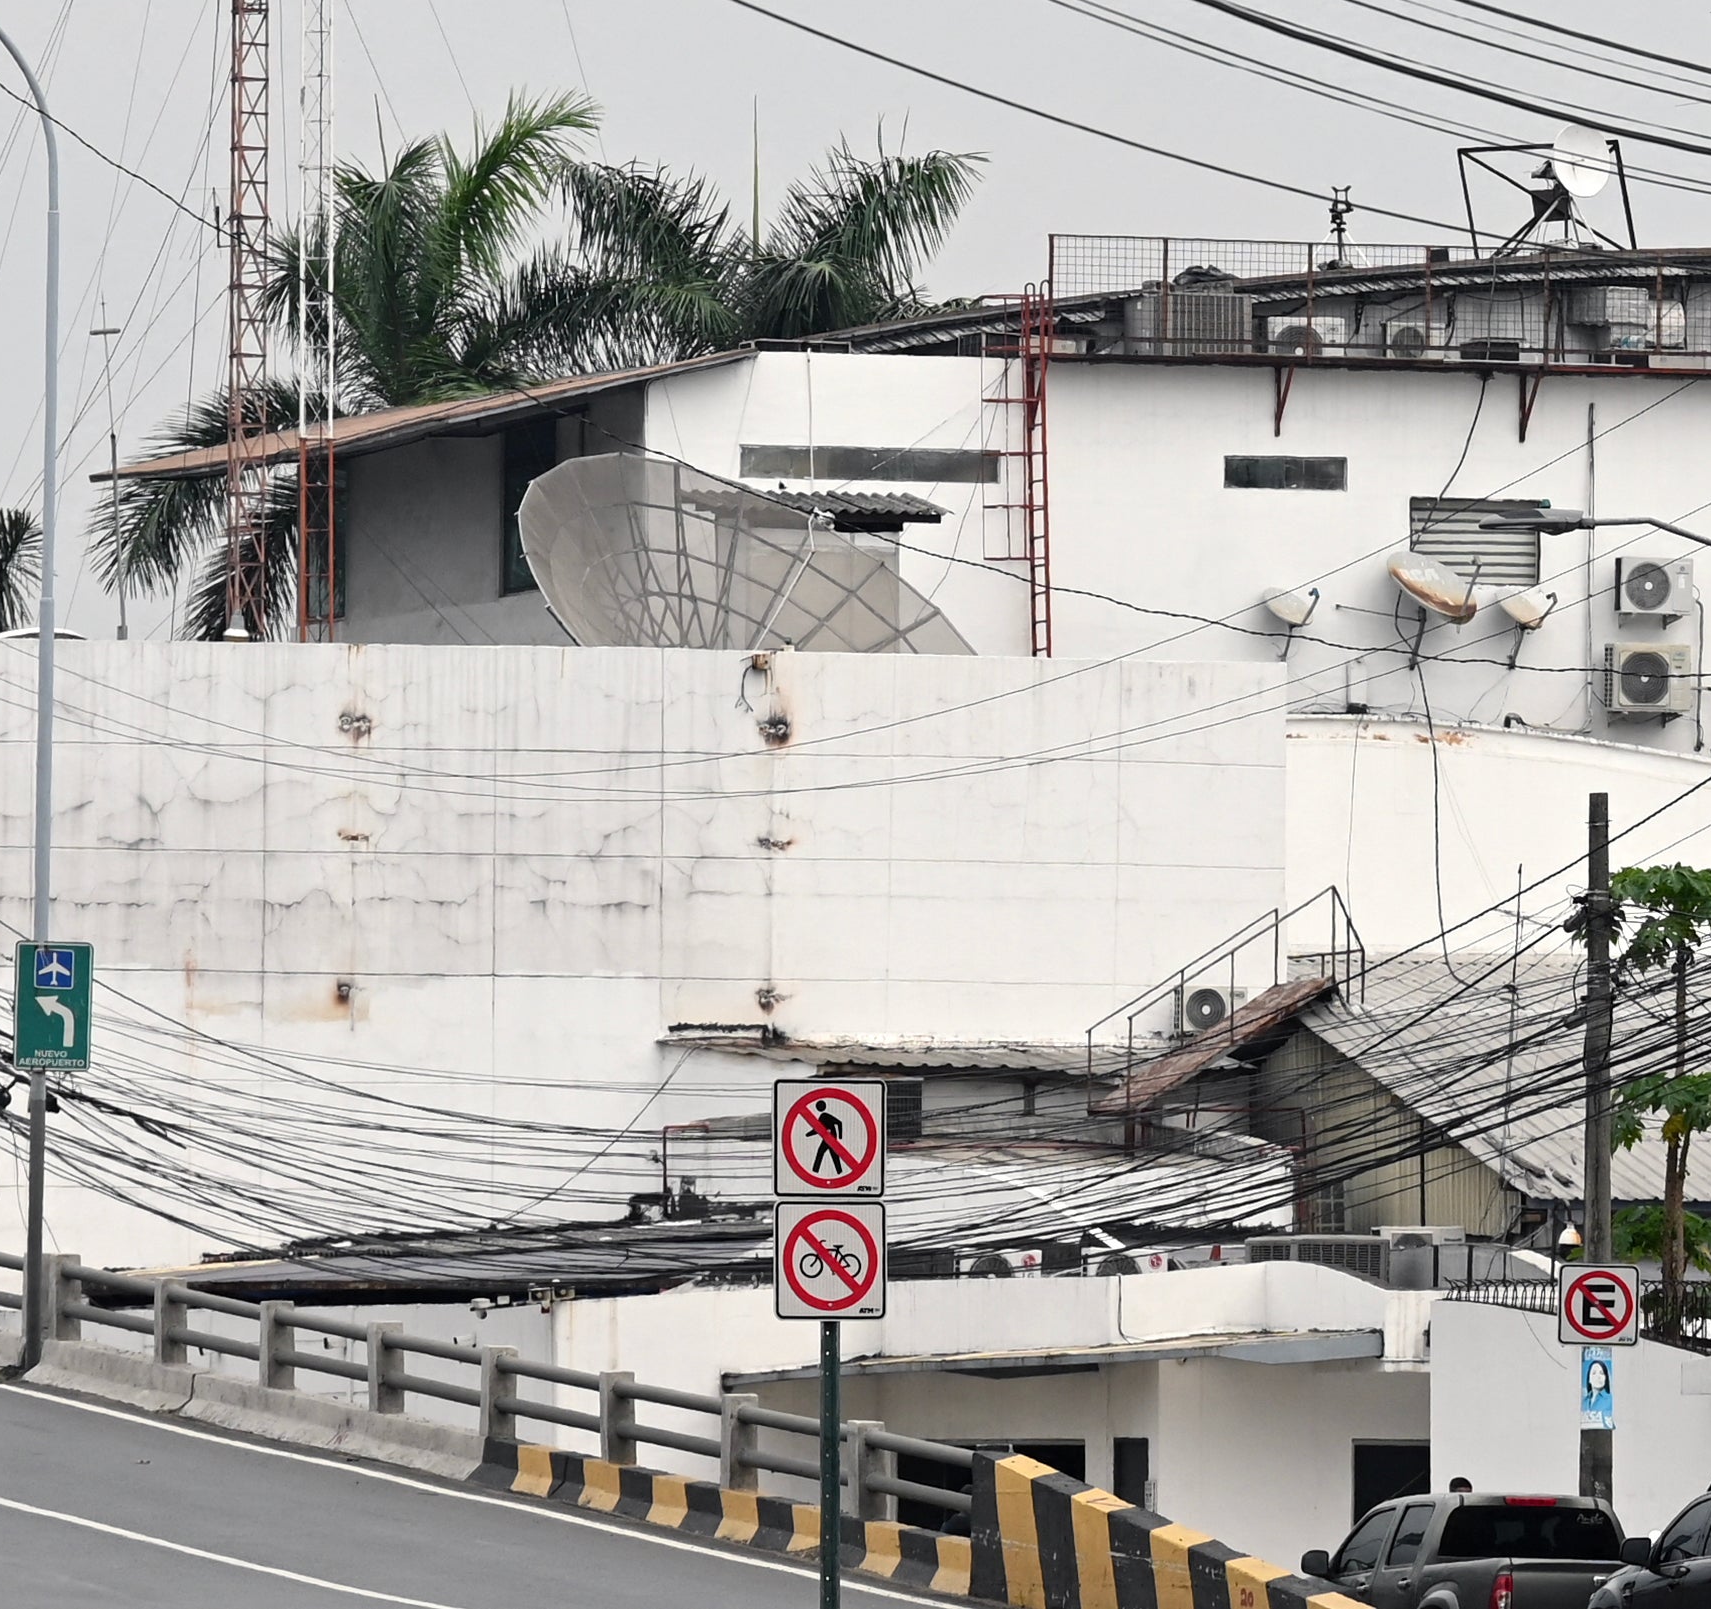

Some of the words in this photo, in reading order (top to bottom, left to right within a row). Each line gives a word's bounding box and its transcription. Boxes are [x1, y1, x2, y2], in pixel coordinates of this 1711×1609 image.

[34, 1049, 68, 1058] NUEVO
[18, 1057, 85, 1068] AEROPUERTO
[1240, 1587, 1254, 1607] 20
